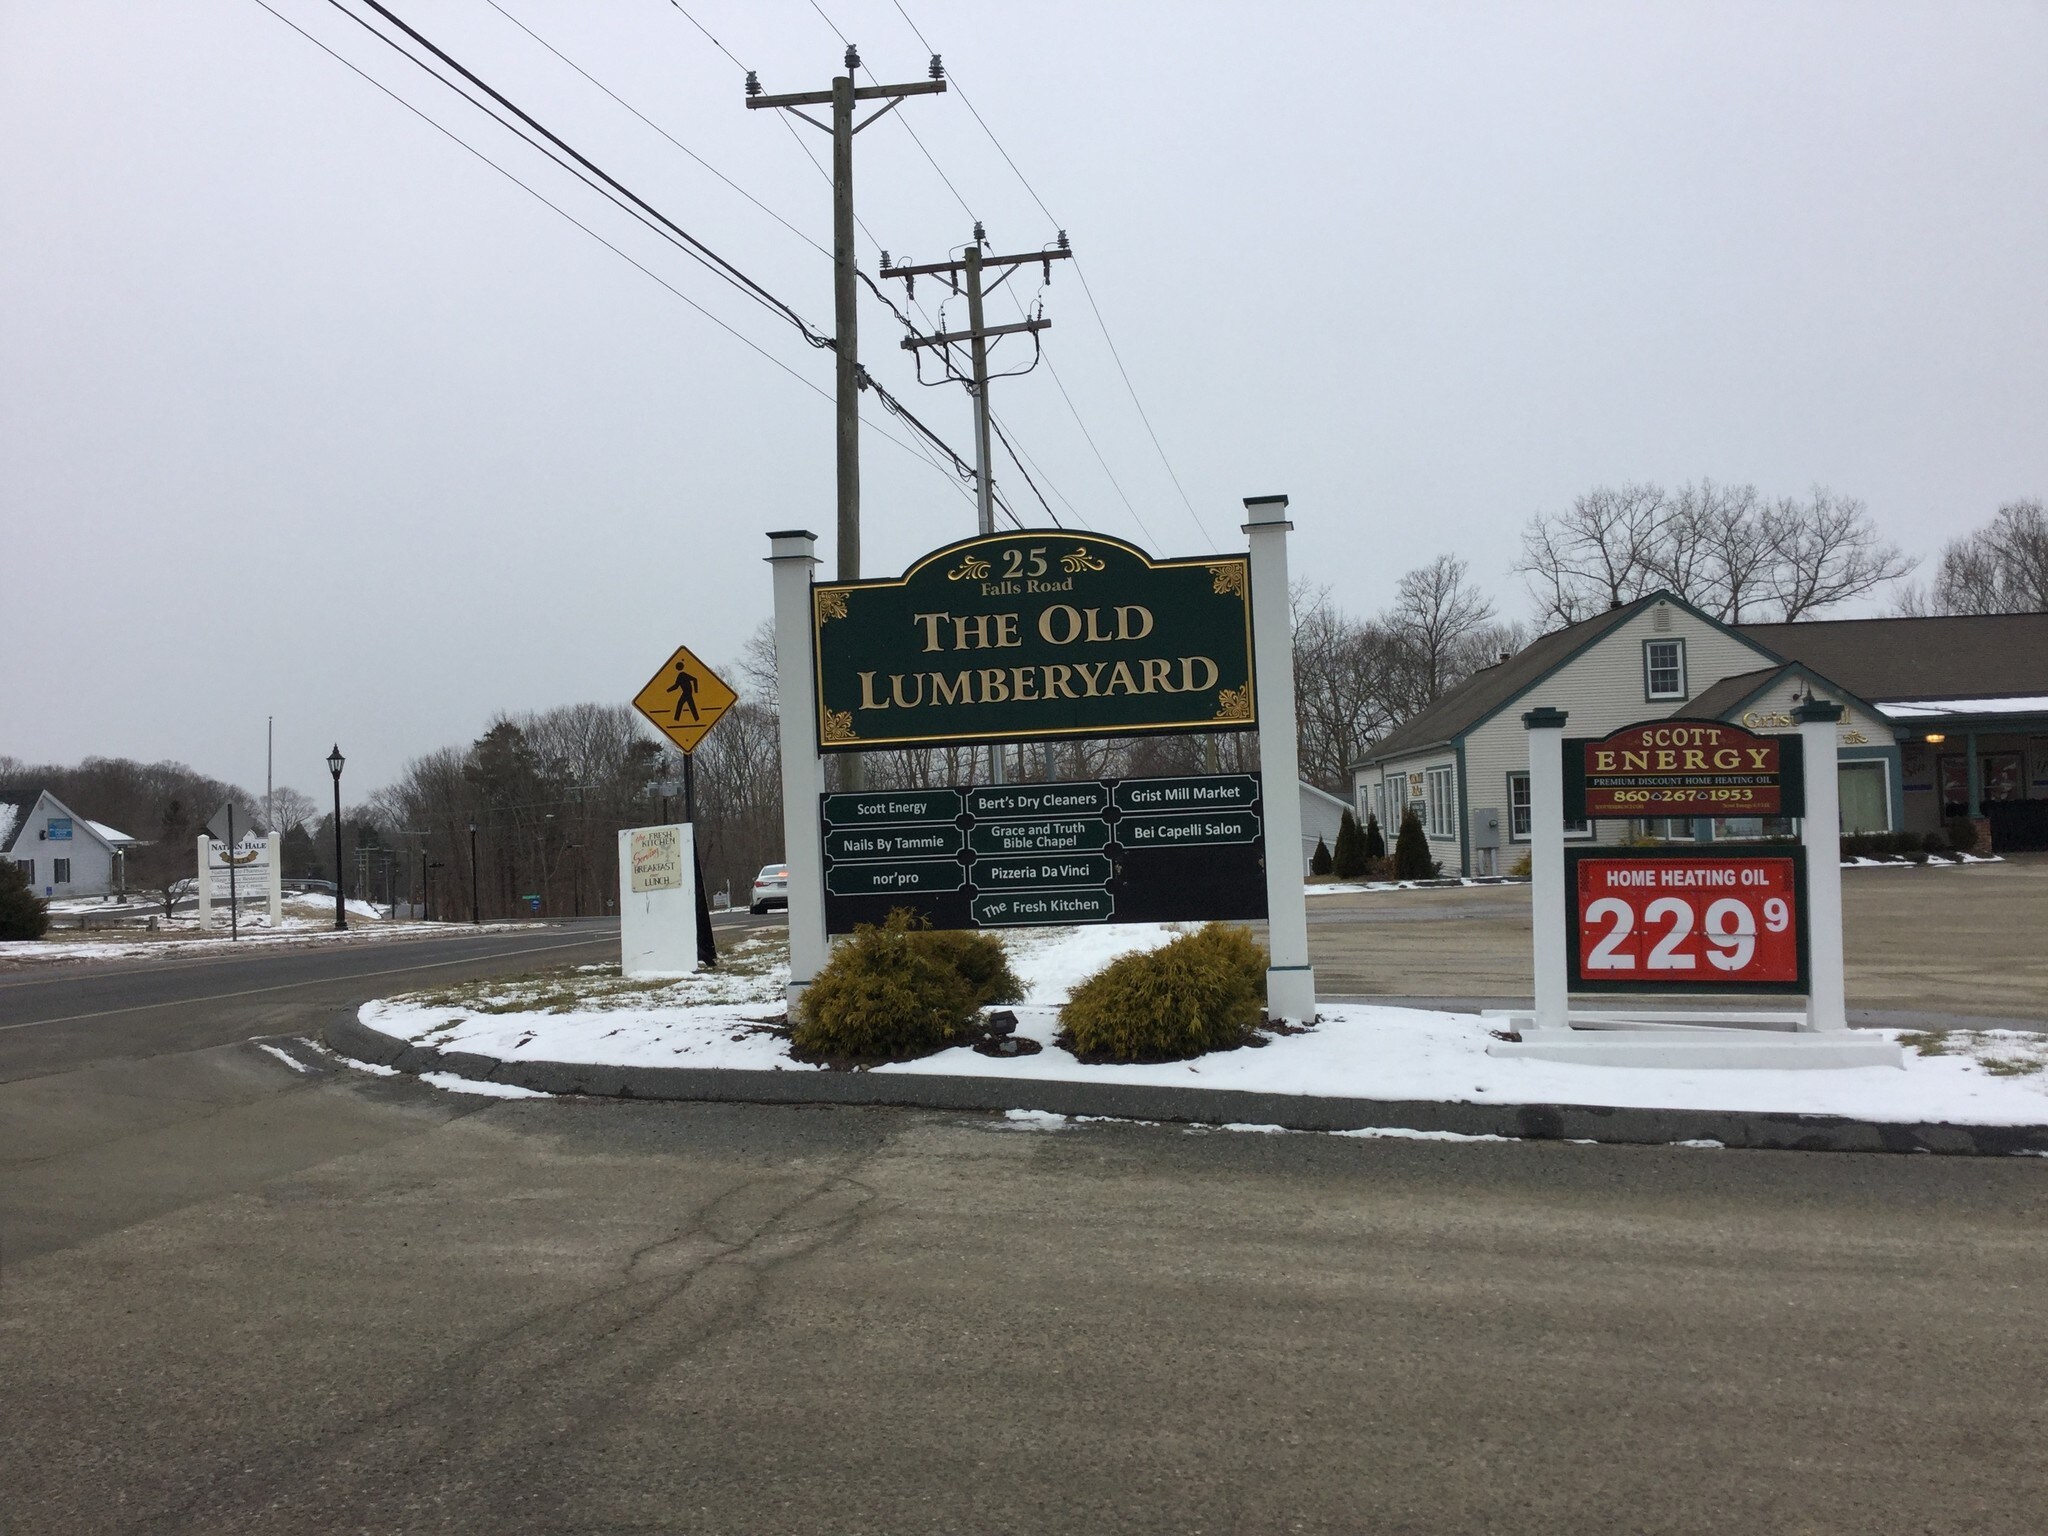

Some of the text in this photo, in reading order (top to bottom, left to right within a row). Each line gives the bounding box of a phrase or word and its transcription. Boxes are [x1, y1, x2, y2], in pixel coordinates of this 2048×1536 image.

[1002, 546, 1048, 579] 25
[982, 577, 1073, 597] Falls Road
[914, 604, 1154, 653] THE OLD
[857, 655, 1220, 711] LUMBERYARD
[1642, 728, 1722, 747] SCOTT
[1595, 748, 1771, 771] ENERGY
[1594, 776, 1772, 786] PREMIUM DISCOUNT HOME HEATING OIL
[978, 793, 1097, 810] Bert's Dry Cleaners
[1131, 786, 1240, 802] Grist Mill Market
[1614, 789, 1754, 802] 860 267 1953
[857, 801, 927, 817] Scott Energy
[649, 831, 672, 839] FRESH
[991, 822, 1085, 837] Grace and Truth
[1134, 821, 1241, 840] Bei Capelli Salon
[642, 838, 676, 847] KITCHEN
[843, 836, 944, 854] Nails By Tammie
[1003, 835, 1077, 850] Bible Chapel
[634, 862, 675, 874] BREAKFAST
[991, 864, 1090, 879] Pizzeria Da Vinci
[645, 876, 670, 886] LUNCH
[873, 871, 919, 887] nor'pro
[1606, 868, 1770, 887] HOME HEATING OIL
[983, 898, 1099, 919] The Fresh Kitchen
[1585, 897, 1789, 971] 229 9
